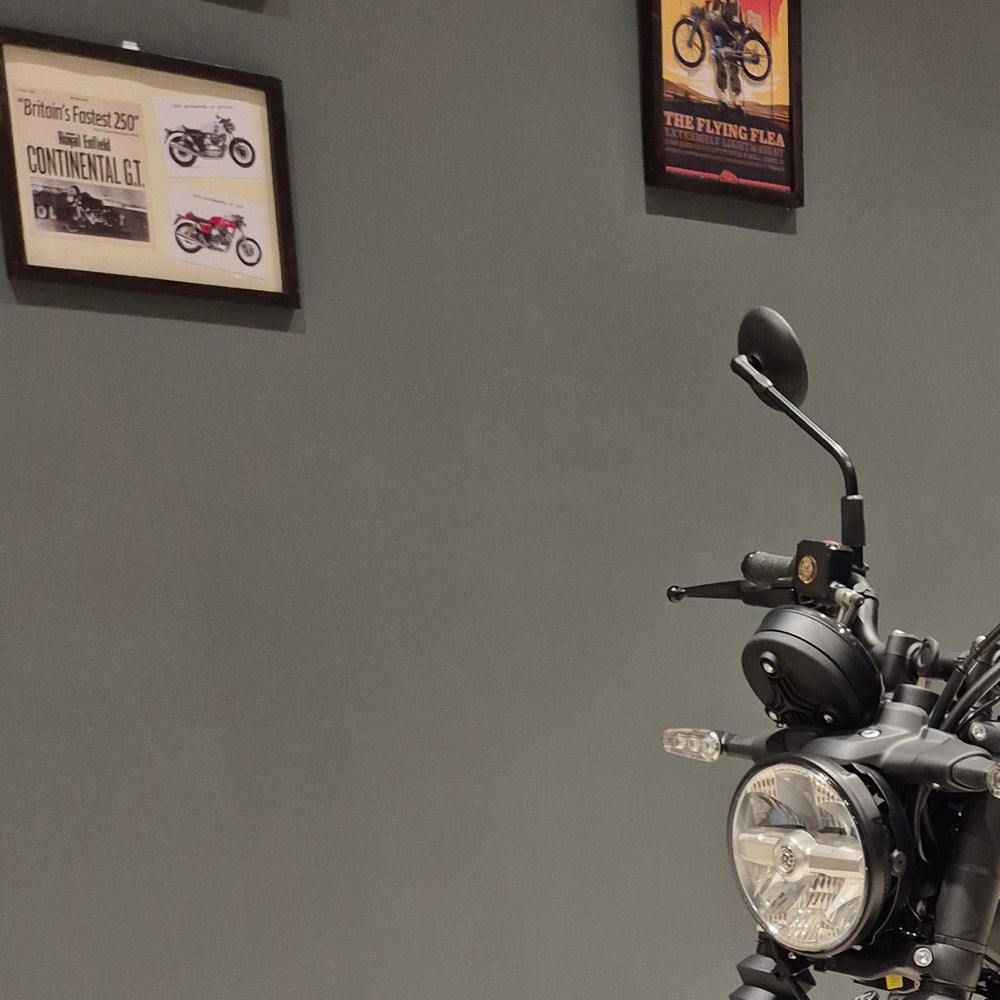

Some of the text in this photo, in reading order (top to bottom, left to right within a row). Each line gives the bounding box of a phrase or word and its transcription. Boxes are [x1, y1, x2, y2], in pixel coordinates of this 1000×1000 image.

[72, 105, 112, 129] Fastest
[664, 111, 785, 148] THE FLYING FLEA
[26, 144, 146, 188] CONTINENTAL G.T.
